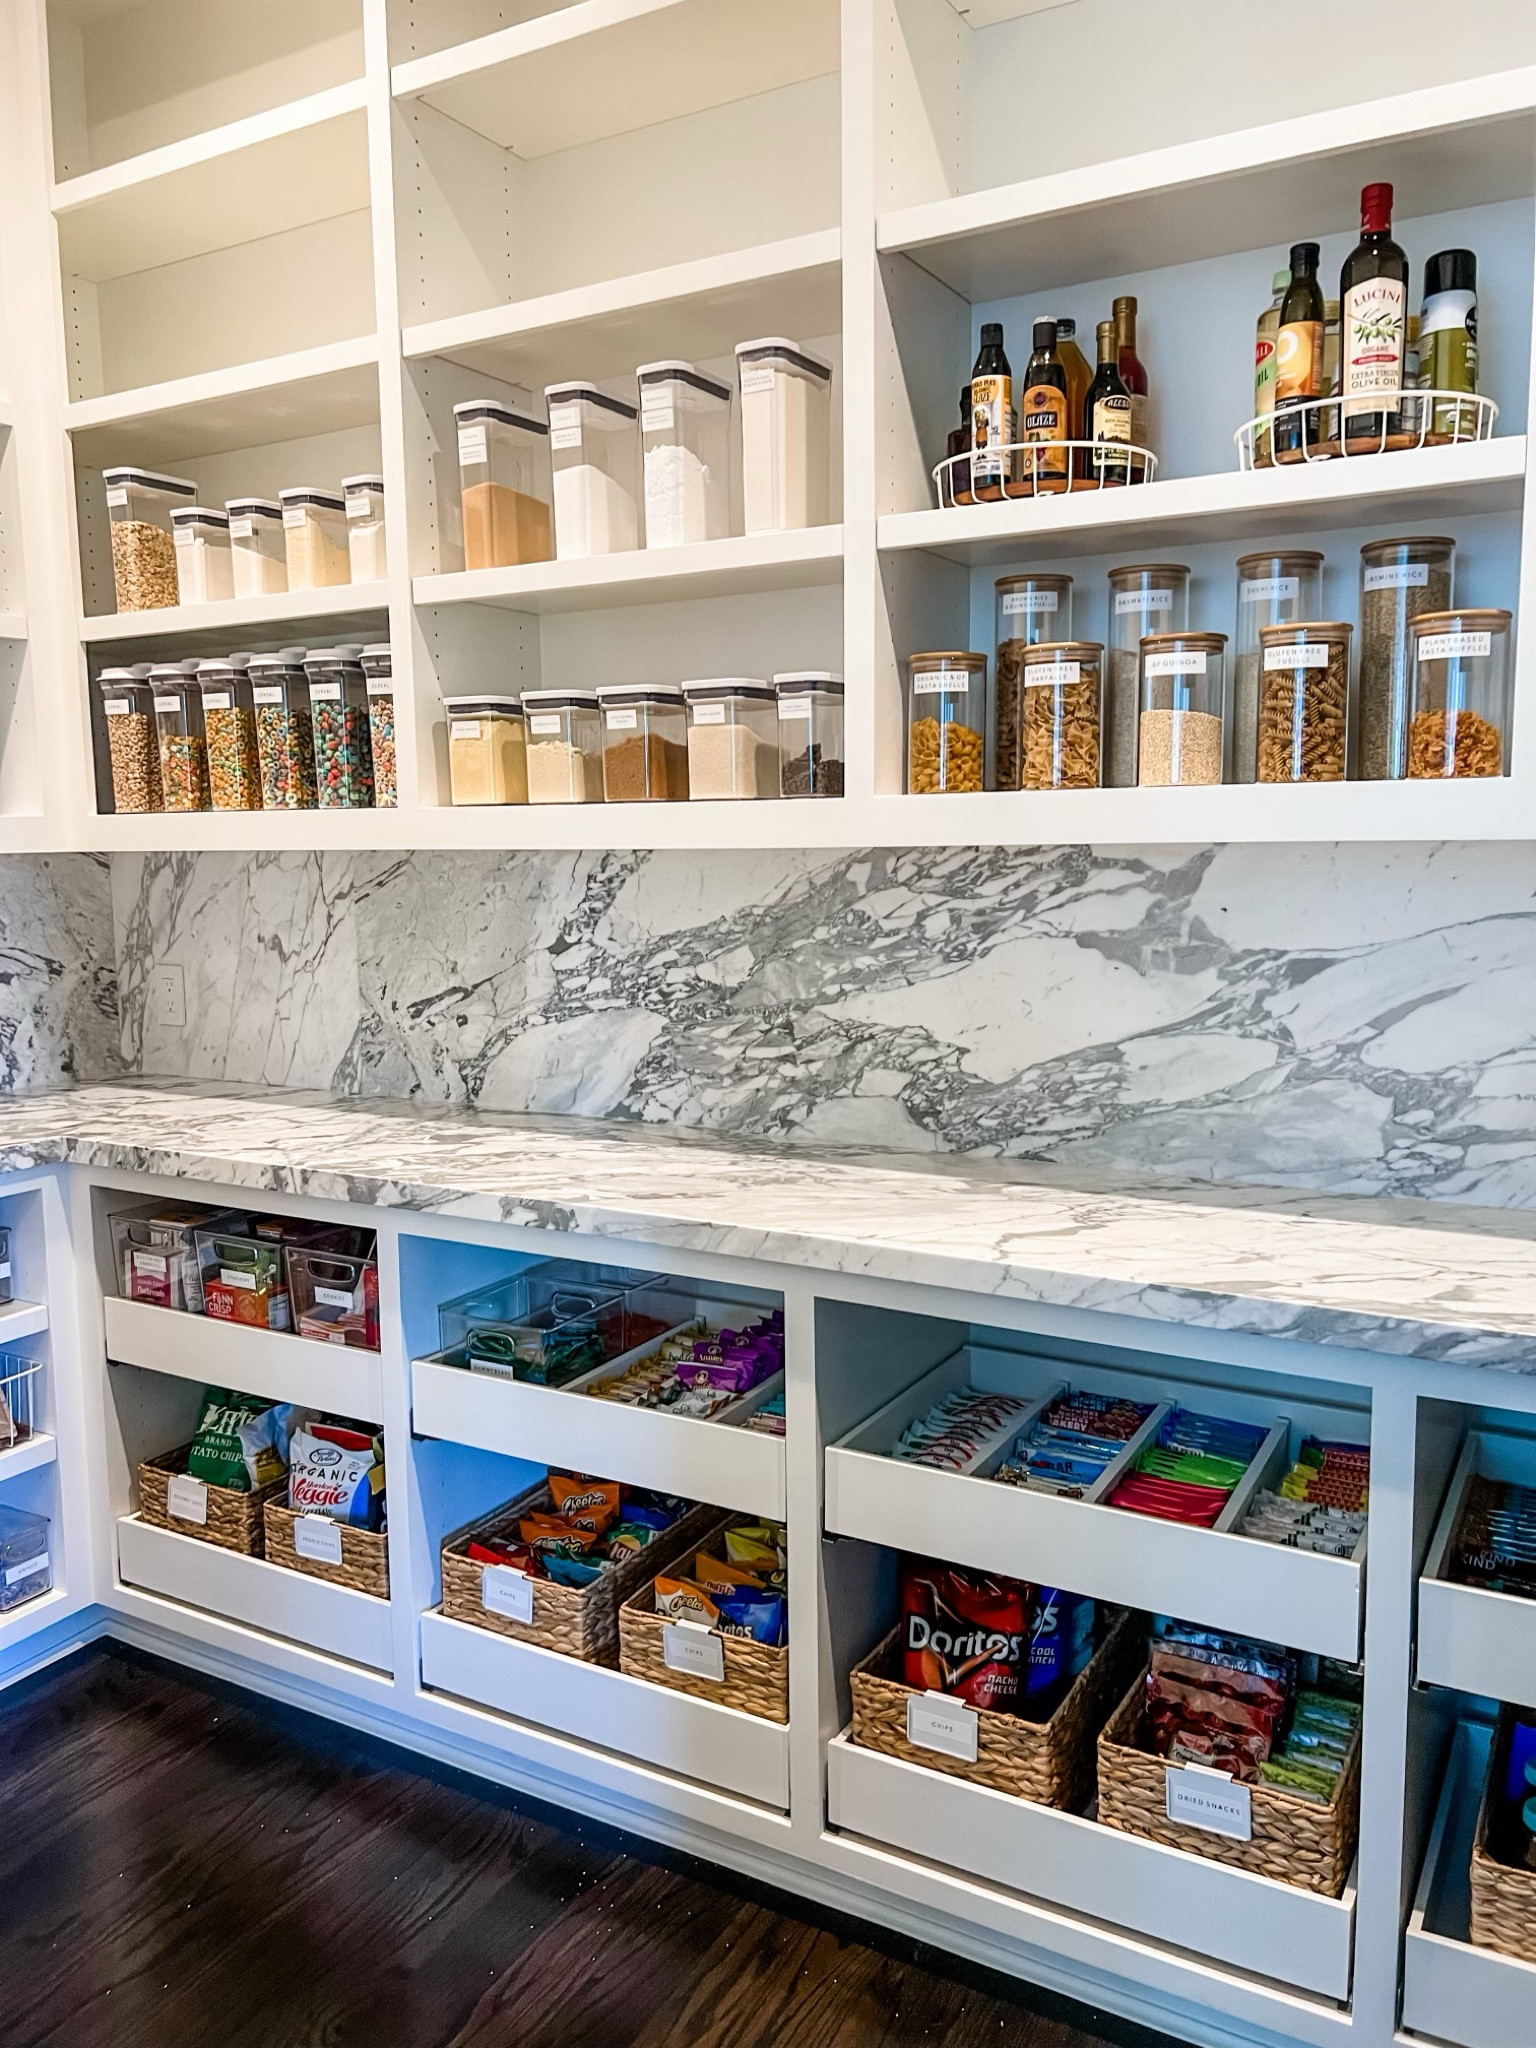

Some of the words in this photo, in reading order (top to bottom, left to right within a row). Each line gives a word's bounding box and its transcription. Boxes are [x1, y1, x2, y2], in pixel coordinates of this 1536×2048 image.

[1354, 288, 1400, 307] LUCINI
[1351, 370, 1374, 380] EXTRA
[1376, 369, 1399, 378] VIRGIN
[1351, 378, 1380, 389] OLIVE
[1383, 377, 1397, 386] OIL
[1402, 571, 1423, 579] RICE
[1425, 637, 1450, 646] PLANT
[1453, 636, 1485, 644] BASED
[1268, 649, 1297, 657] GLUTEN
[1421, 647, 1446, 656] PASTA
[1162, 659, 1198, 667] QUINOA
[1028, 666, 1052, 675] GLUTEN
[938, 681, 965, 689] SHELLS
[323, 1293, 345, 1302] COOKIES
[208, 1301, 232, 1315] CRISP
[204, 1435, 233, 1447] BRAND
[292, 1476, 349, 1506] Veggie
[562, 1492, 606, 1514] Cheetos
[499, 1590, 516, 1600] CHIPS
[669, 1595, 704, 1612] Cheetos
[909, 1615, 1023, 1662] Doritos
[684, 1647, 703, 1657] CHIPS
[988, 1674, 1019, 1686] NACHO
[983, 1684, 1018, 1695] CHEESE
[931, 1721, 954, 1733] CHIPS
[1177, 1793, 1204, 1806] DRIED
[1206, 1801, 1241, 1816] SNACKS
